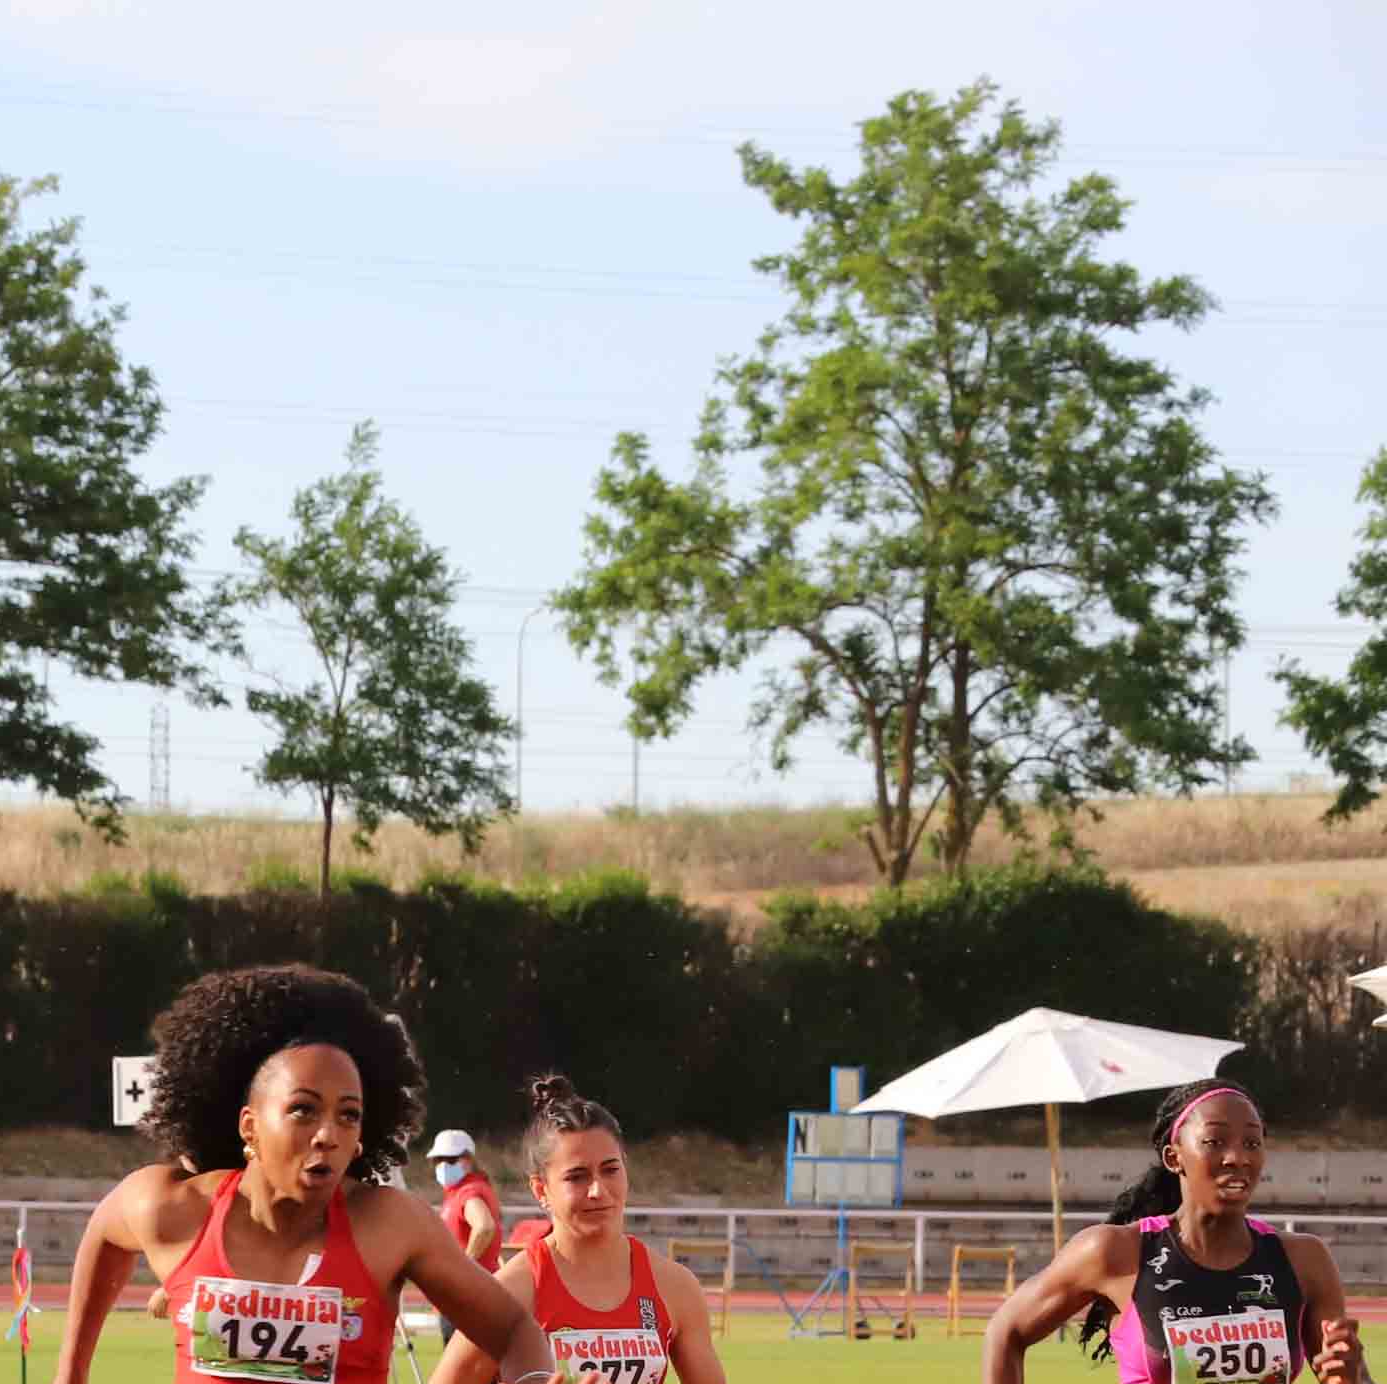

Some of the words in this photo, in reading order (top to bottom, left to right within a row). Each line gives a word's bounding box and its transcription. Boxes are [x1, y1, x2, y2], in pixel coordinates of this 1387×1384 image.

[195, 1283, 339, 1324] bedunia
[220, 1319, 309, 1362] 194
[554, 1336, 663, 1361] bedunia
[1167, 1317, 1285, 1346] bedunia
[1195, 1342, 1267, 1379] 250
